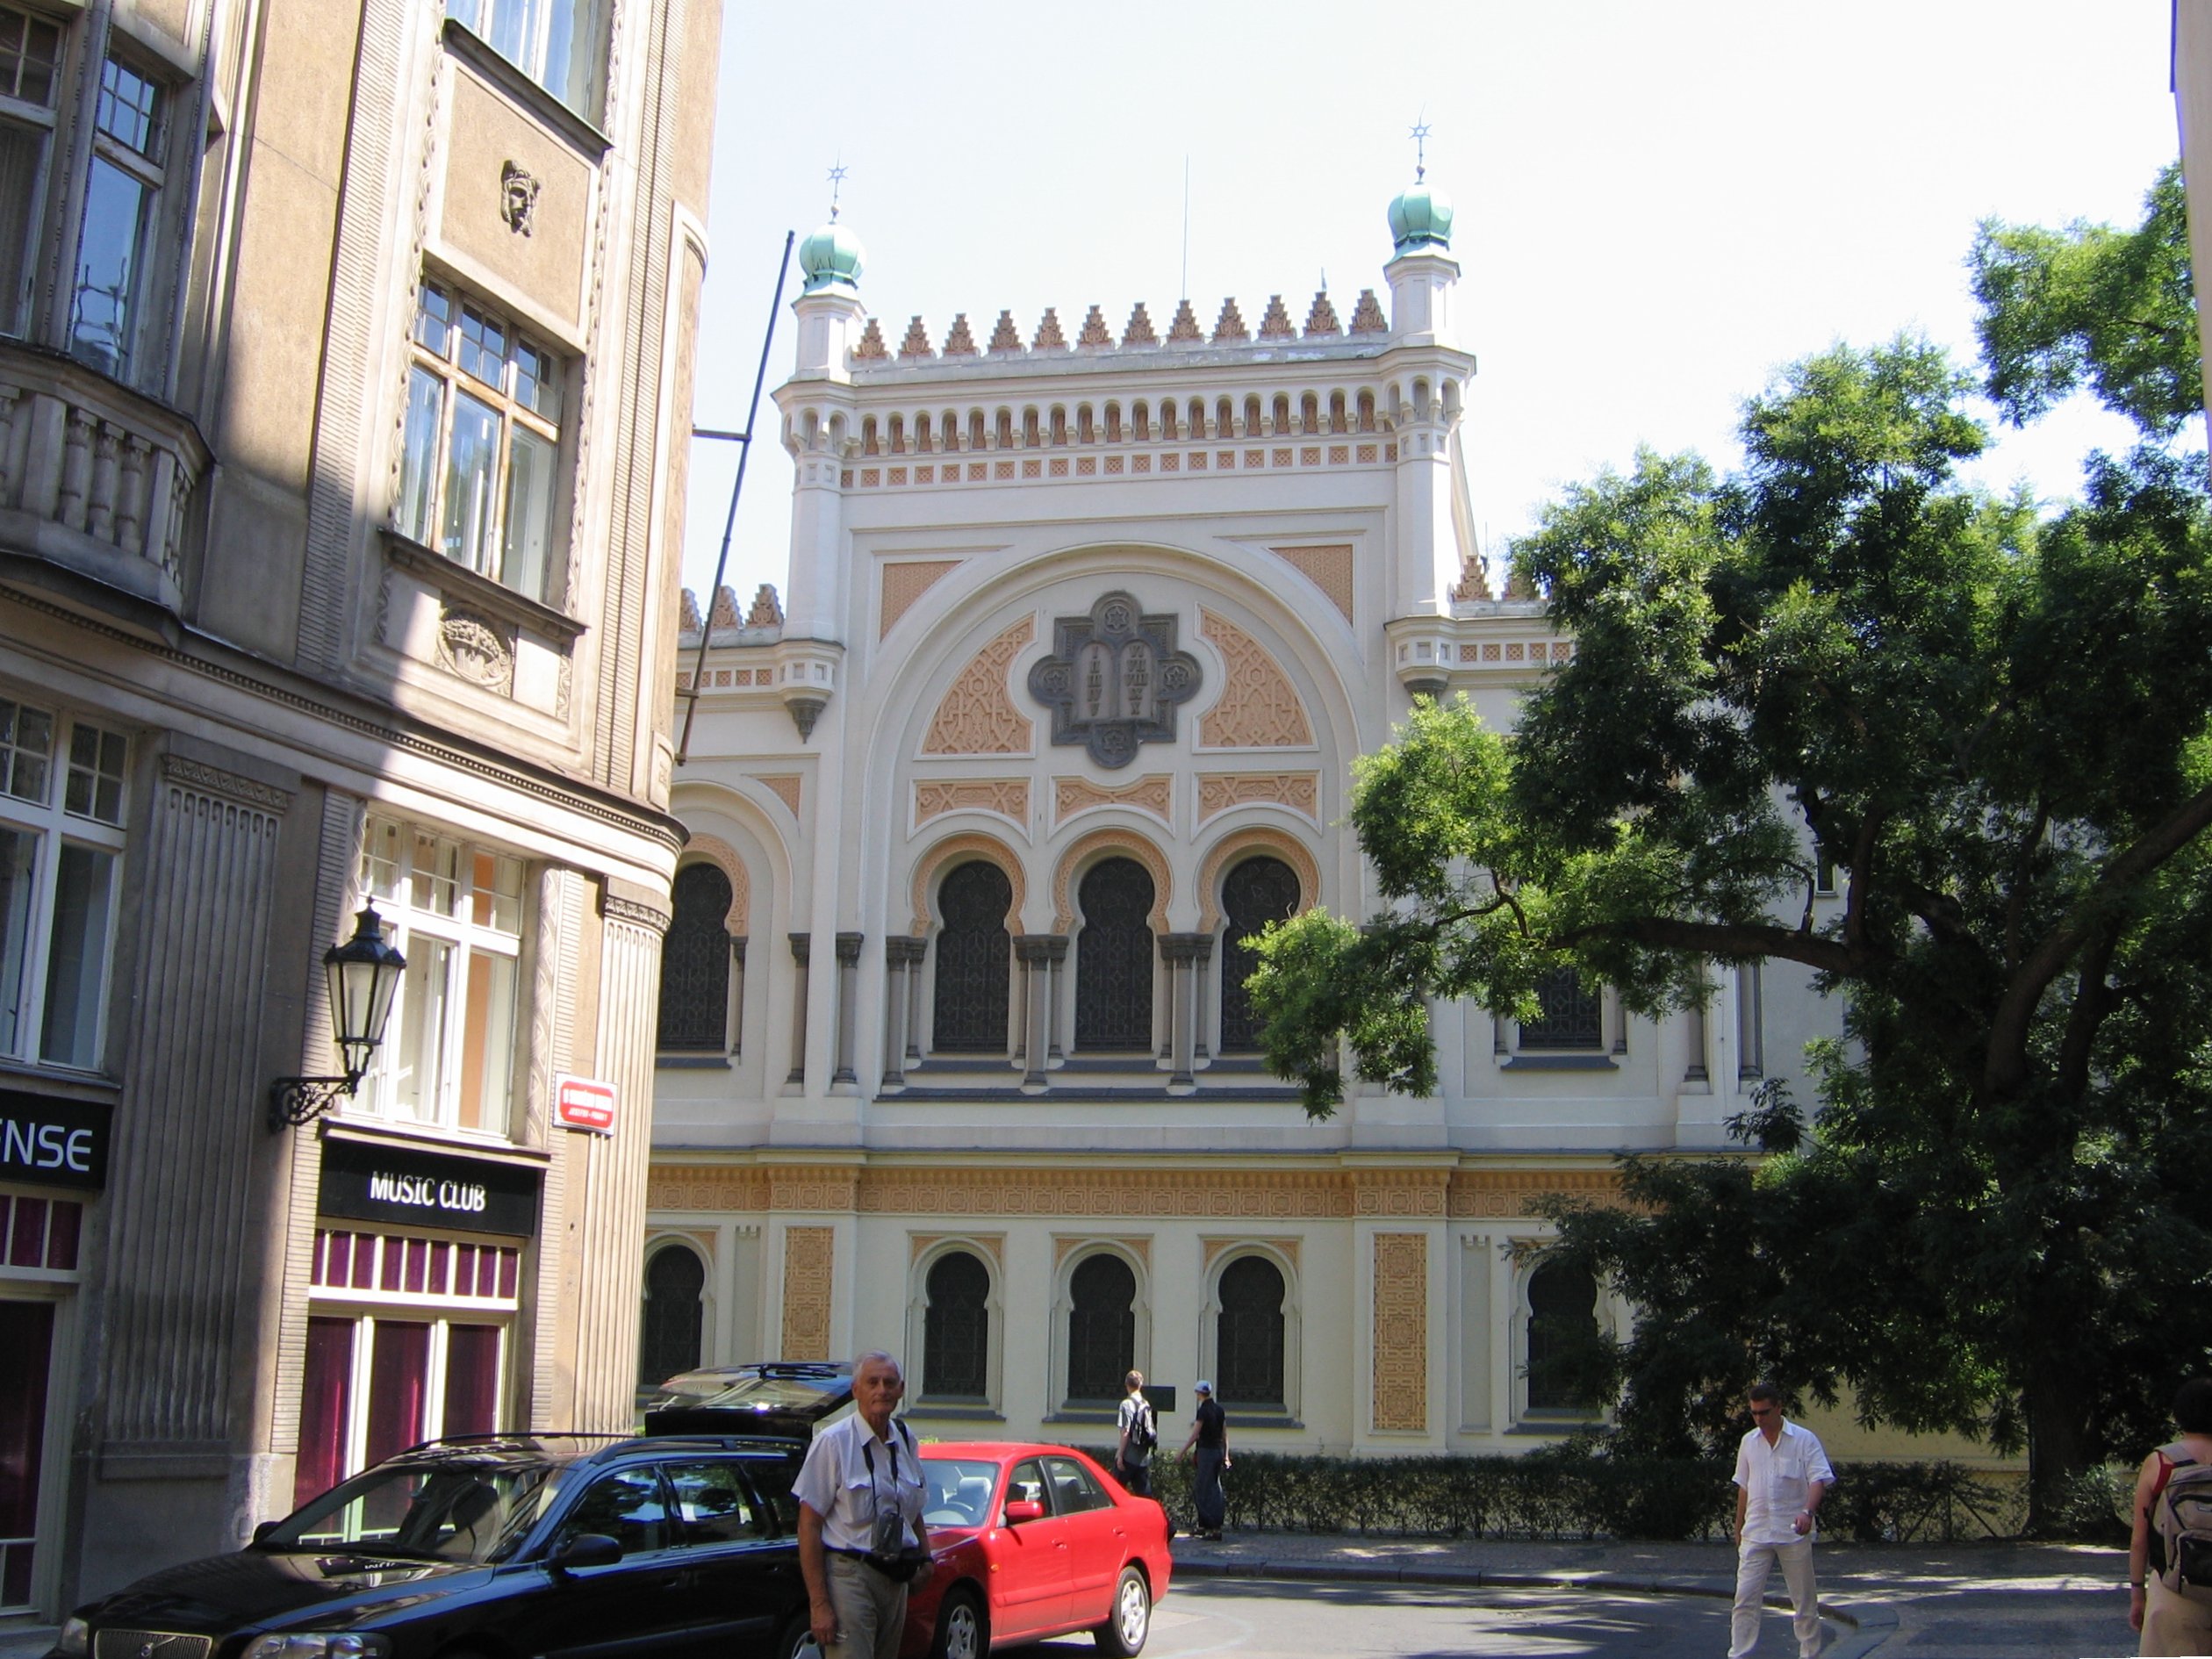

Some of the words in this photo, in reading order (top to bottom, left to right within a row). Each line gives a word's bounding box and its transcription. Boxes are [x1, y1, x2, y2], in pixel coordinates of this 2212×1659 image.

[0, 1117, 93, 1172] NSE
[370, 1170, 435, 1206] MUSIC
[439, 1179, 486, 1211] CLUB
